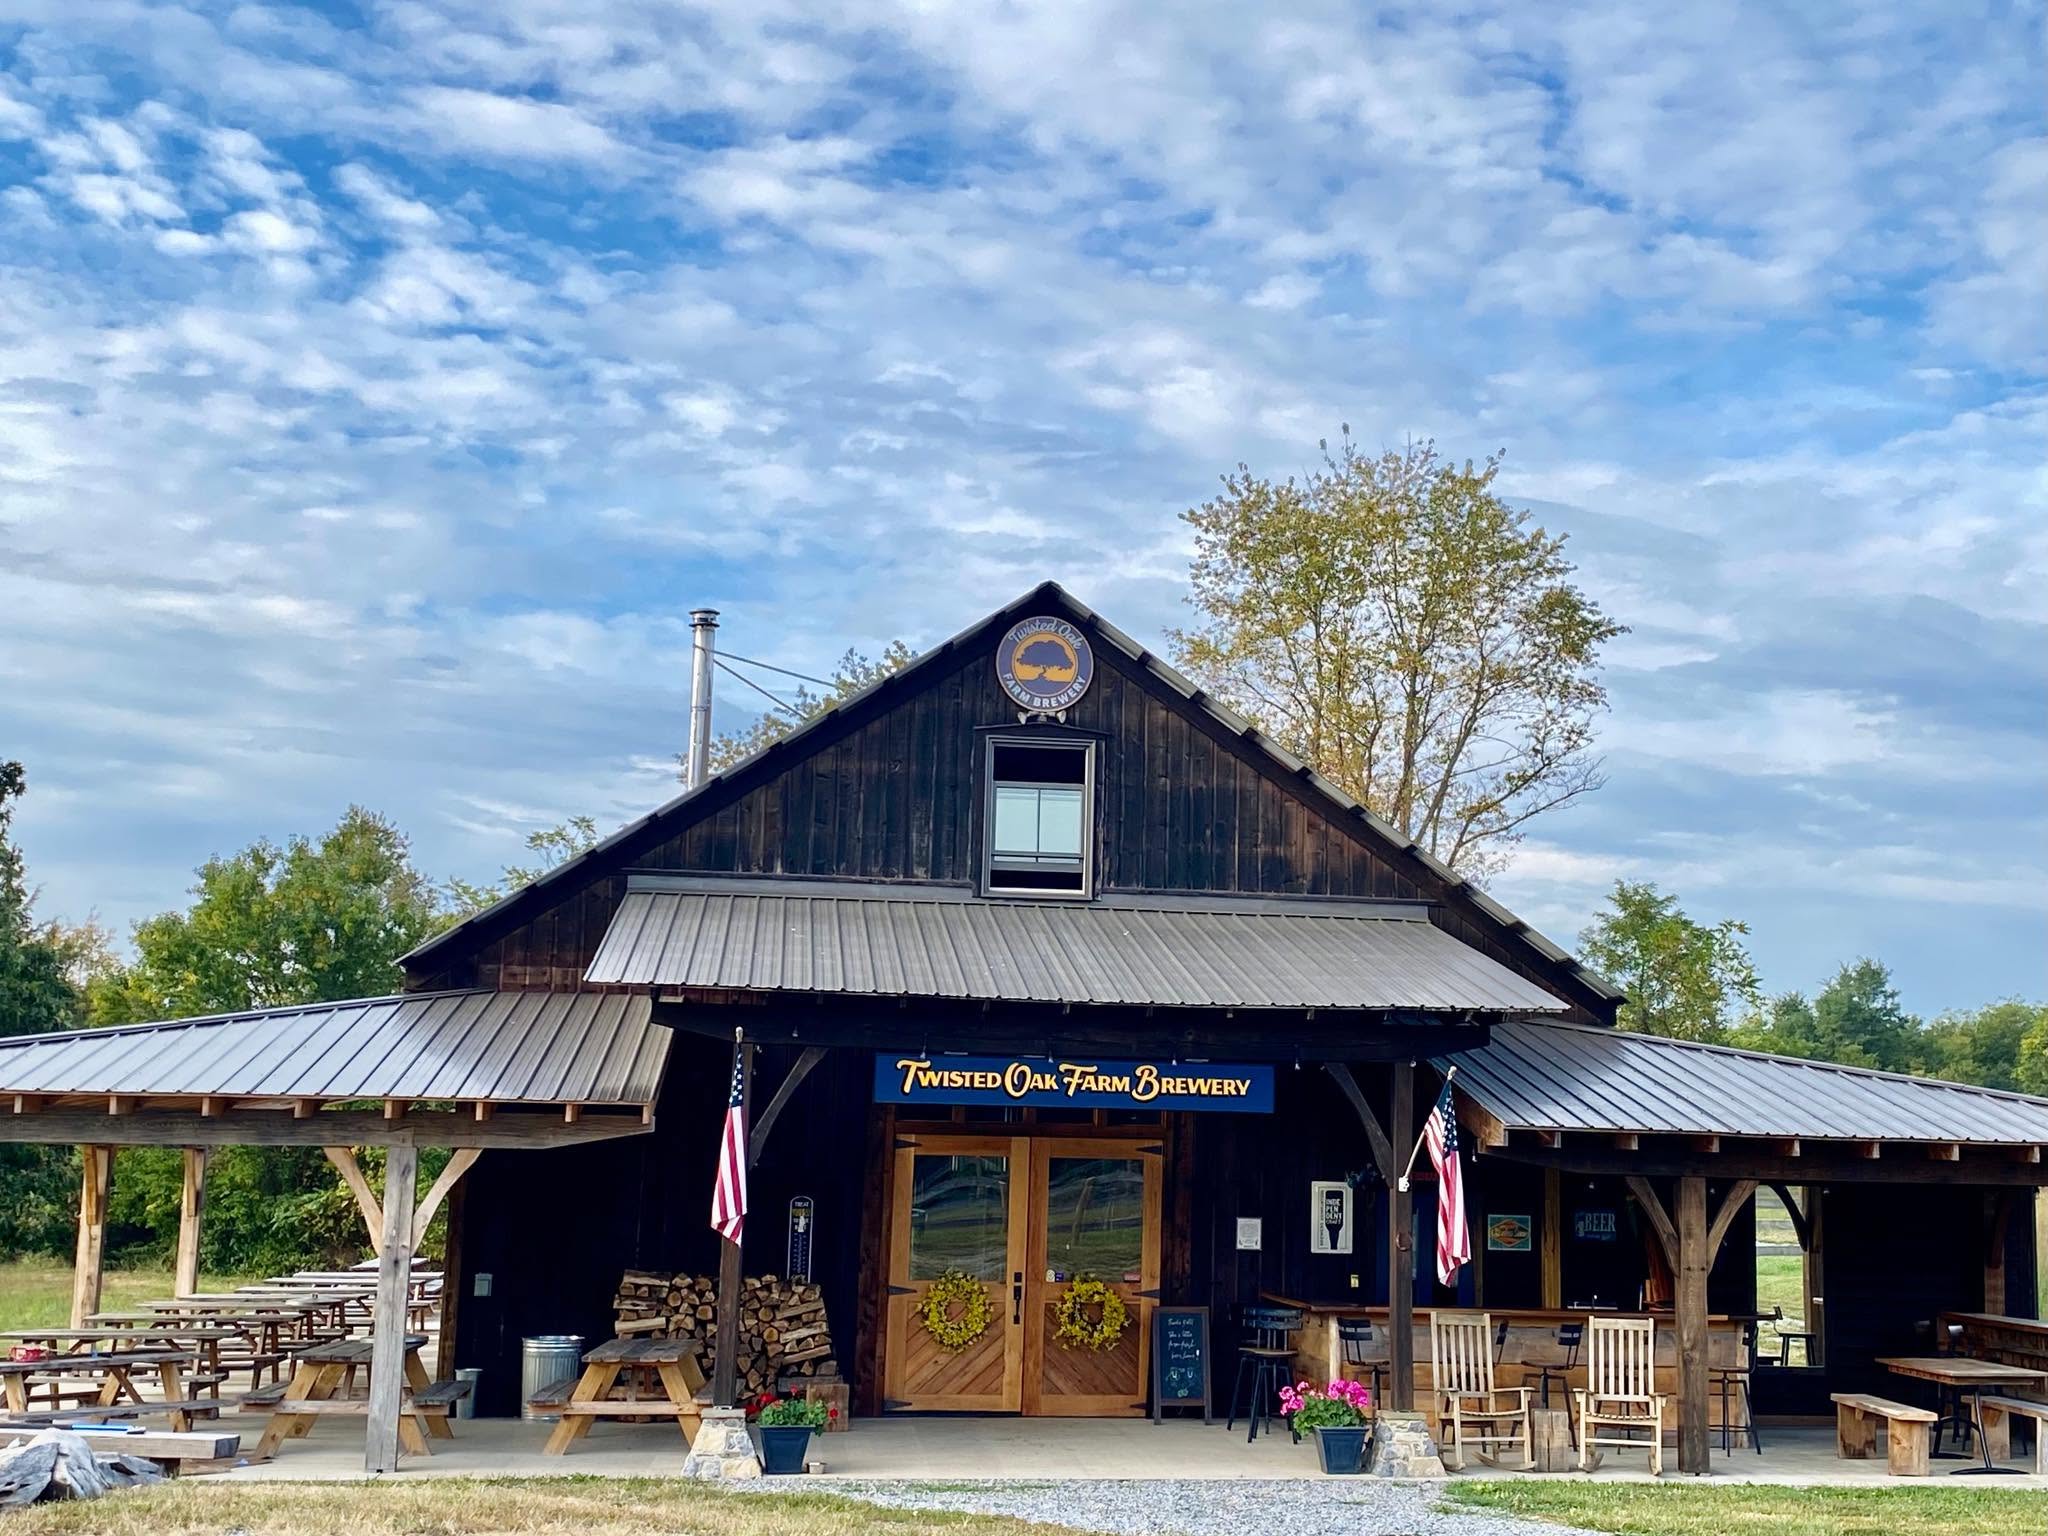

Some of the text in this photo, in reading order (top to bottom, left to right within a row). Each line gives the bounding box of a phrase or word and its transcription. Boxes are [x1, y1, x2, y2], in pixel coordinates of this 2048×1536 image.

[1008, 619, 1083, 650] Twisted Oak
[1003, 672, 1086, 708] FARM BREWERY
[896, 1059, 1251, 1100] TWISTED OAK FARM BREWERY
[1584, 1213, 1616, 1232] BEER
